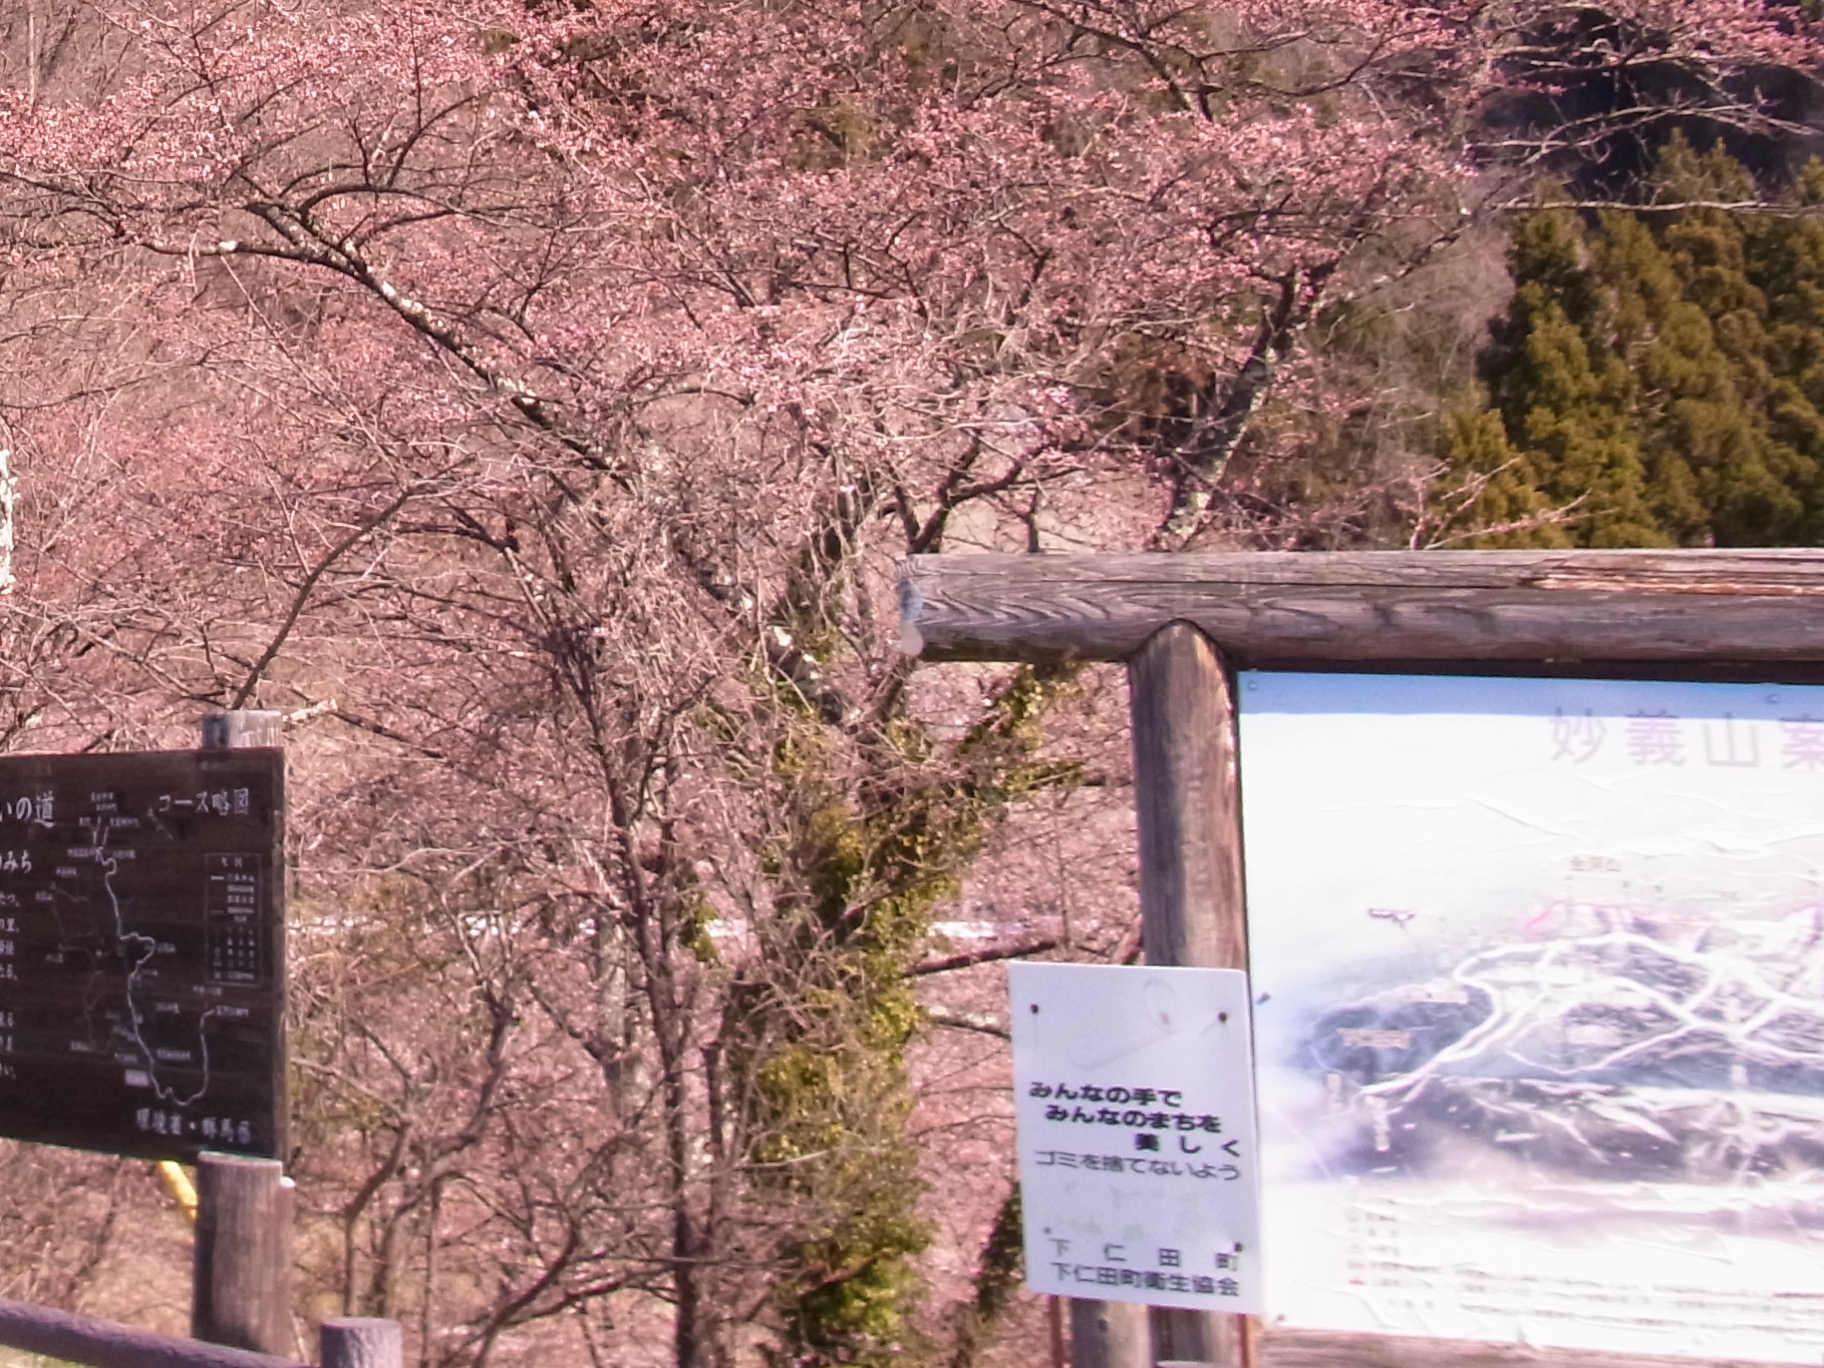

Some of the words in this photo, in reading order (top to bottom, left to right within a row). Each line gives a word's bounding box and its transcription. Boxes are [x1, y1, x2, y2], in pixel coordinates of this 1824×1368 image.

[159, 787, 250, 816] コース略図
[1029, 1081, 1183, 1108] みんなの手で
[1045, 1104, 1222, 1133] みんなのまちを
[1035, 1150, 1241, 1181] ゴミを捨てないよう
[1050, 1262, 1238, 1296] 下仁田町衛生協会
